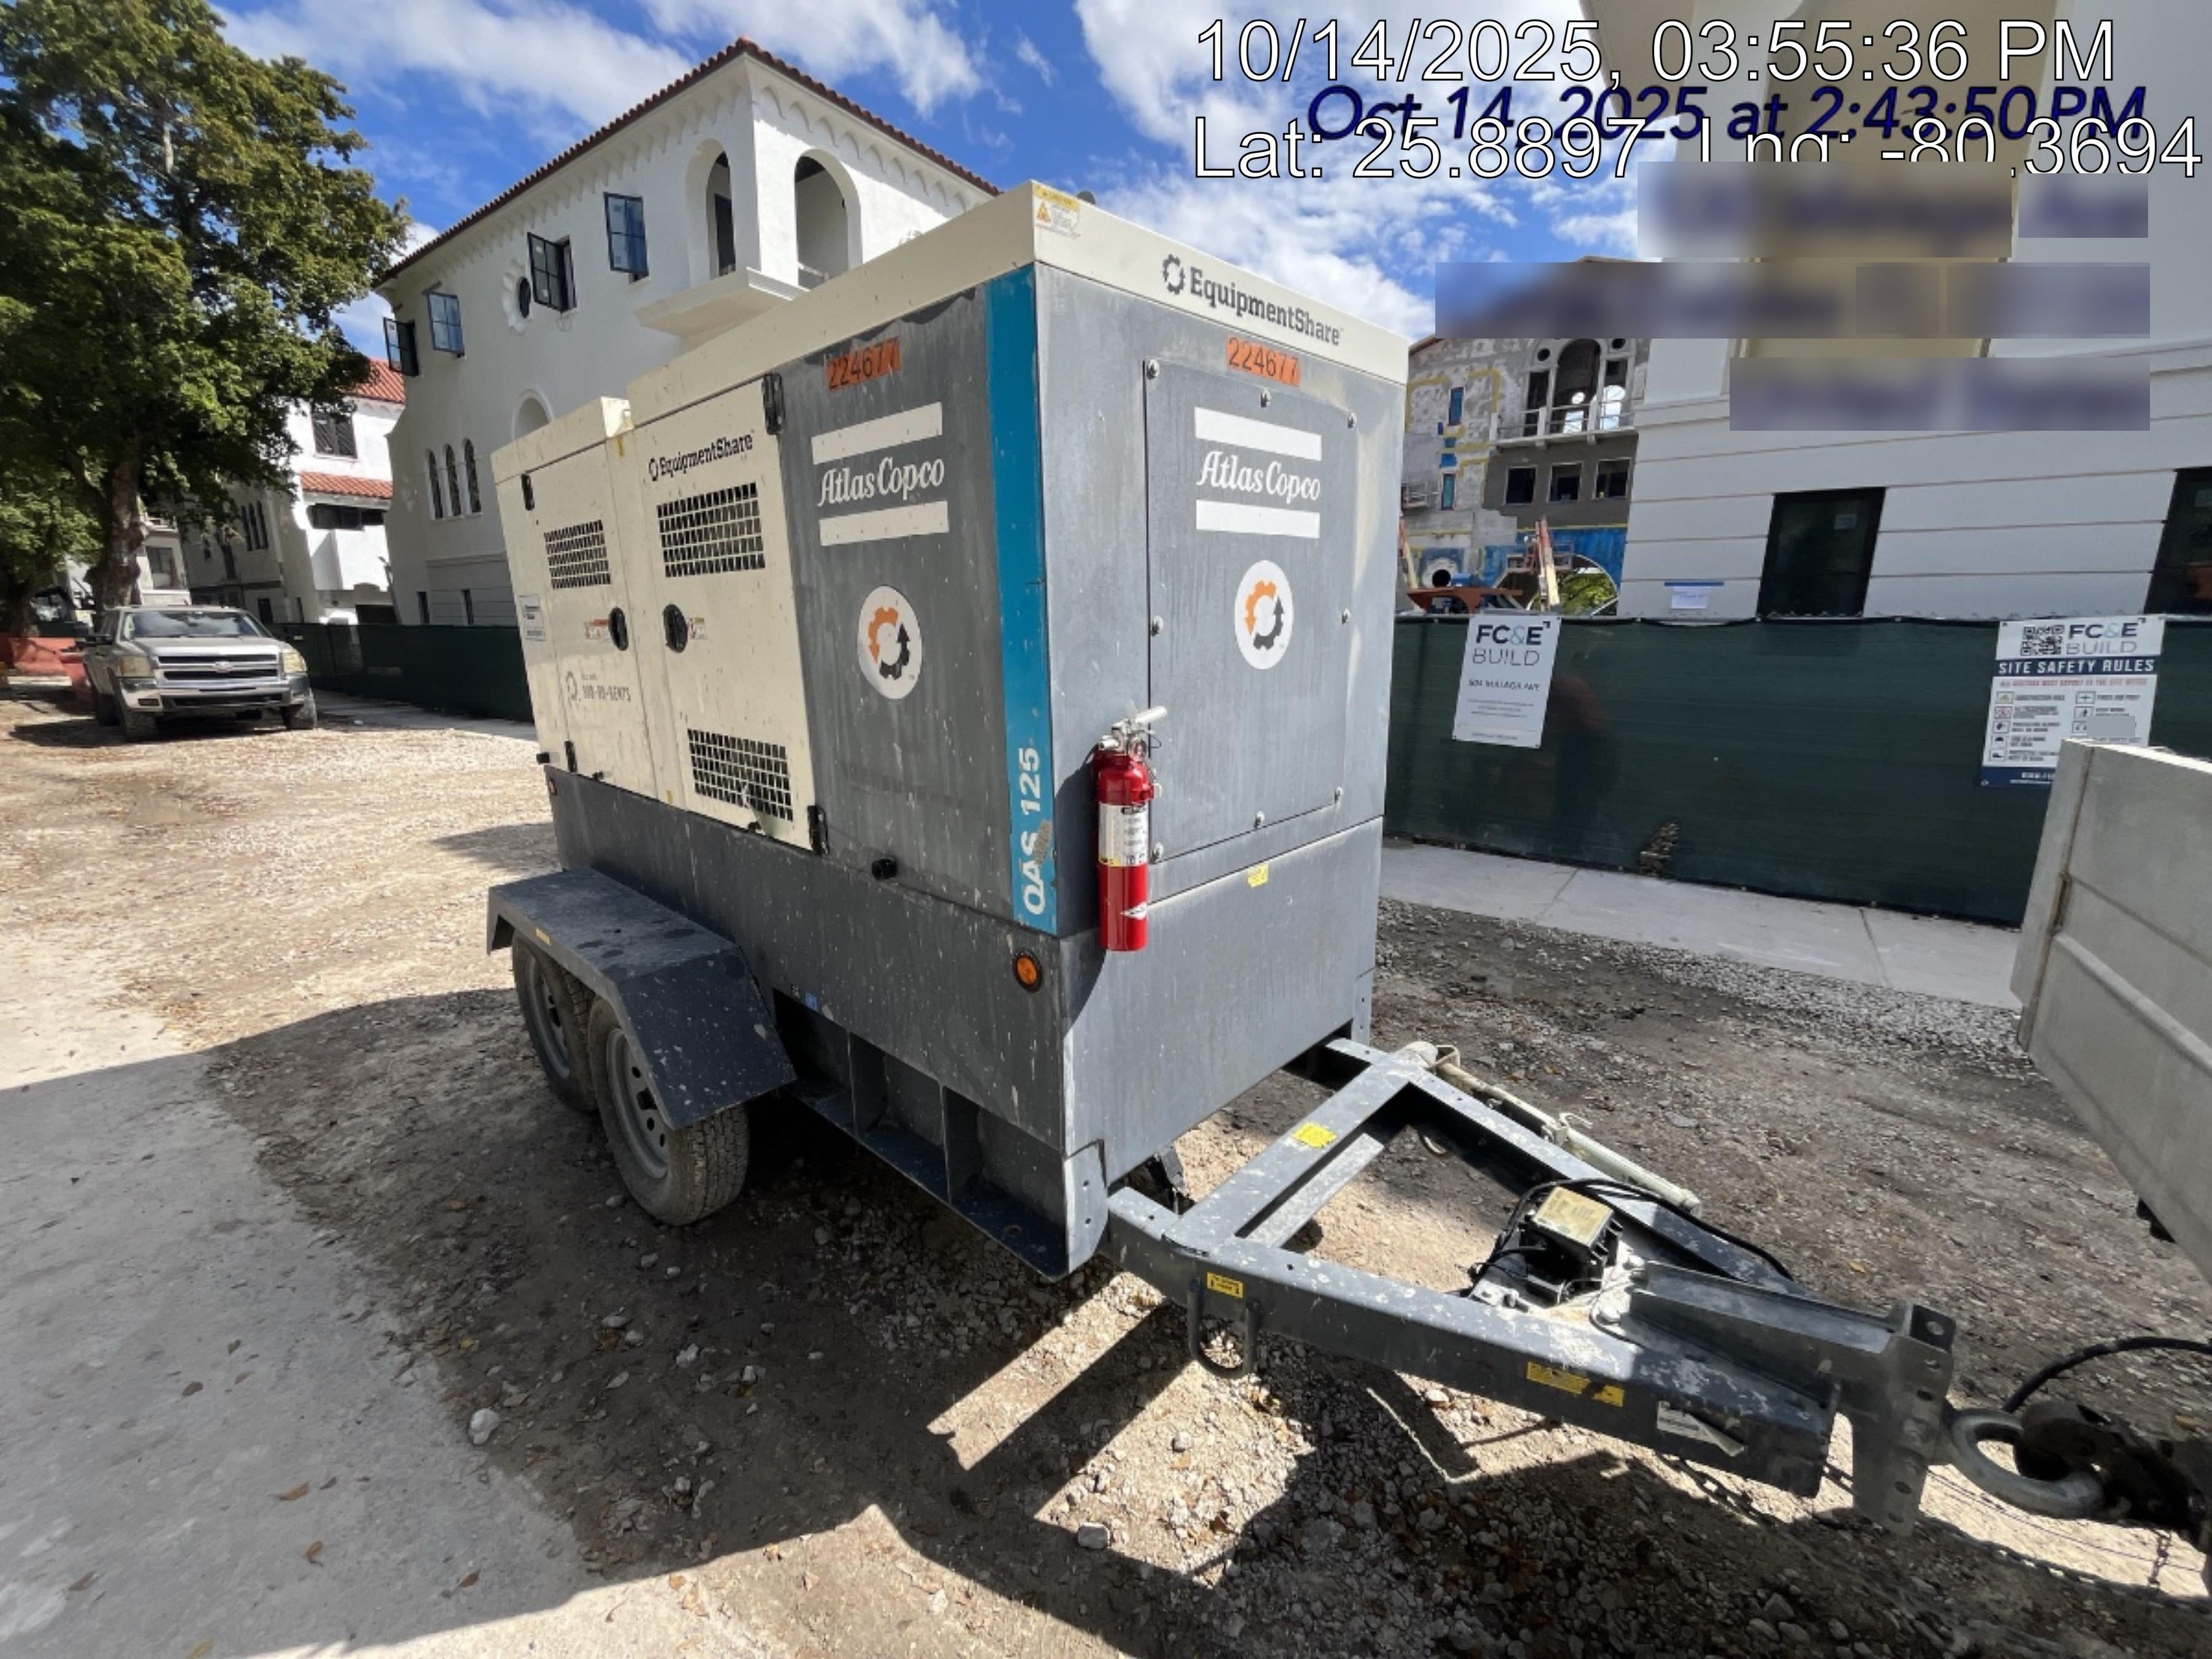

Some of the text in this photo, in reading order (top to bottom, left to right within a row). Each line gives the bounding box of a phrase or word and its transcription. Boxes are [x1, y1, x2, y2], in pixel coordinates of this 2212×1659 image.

[1190, 267, 1341, 345] EquipmentShare
[1229, 337, 1299, 384] 224677
[659, 434, 753, 477] EquipmentShare
[1196, 450, 1320, 504] Atlas Copco
[817, 457, 944, 507] Atlas Copco
[1476, 624, 1544, 645] FC&E
[2066, 641, 2137, 655] BUILD
[2068, 622, 2139, 639] FC&E
[1472, 647, 1540, 666] BUILD
[1998, 659, 2155, 675] SITE SAFETY RULES
[1019, 747, 1041, 816] 125
